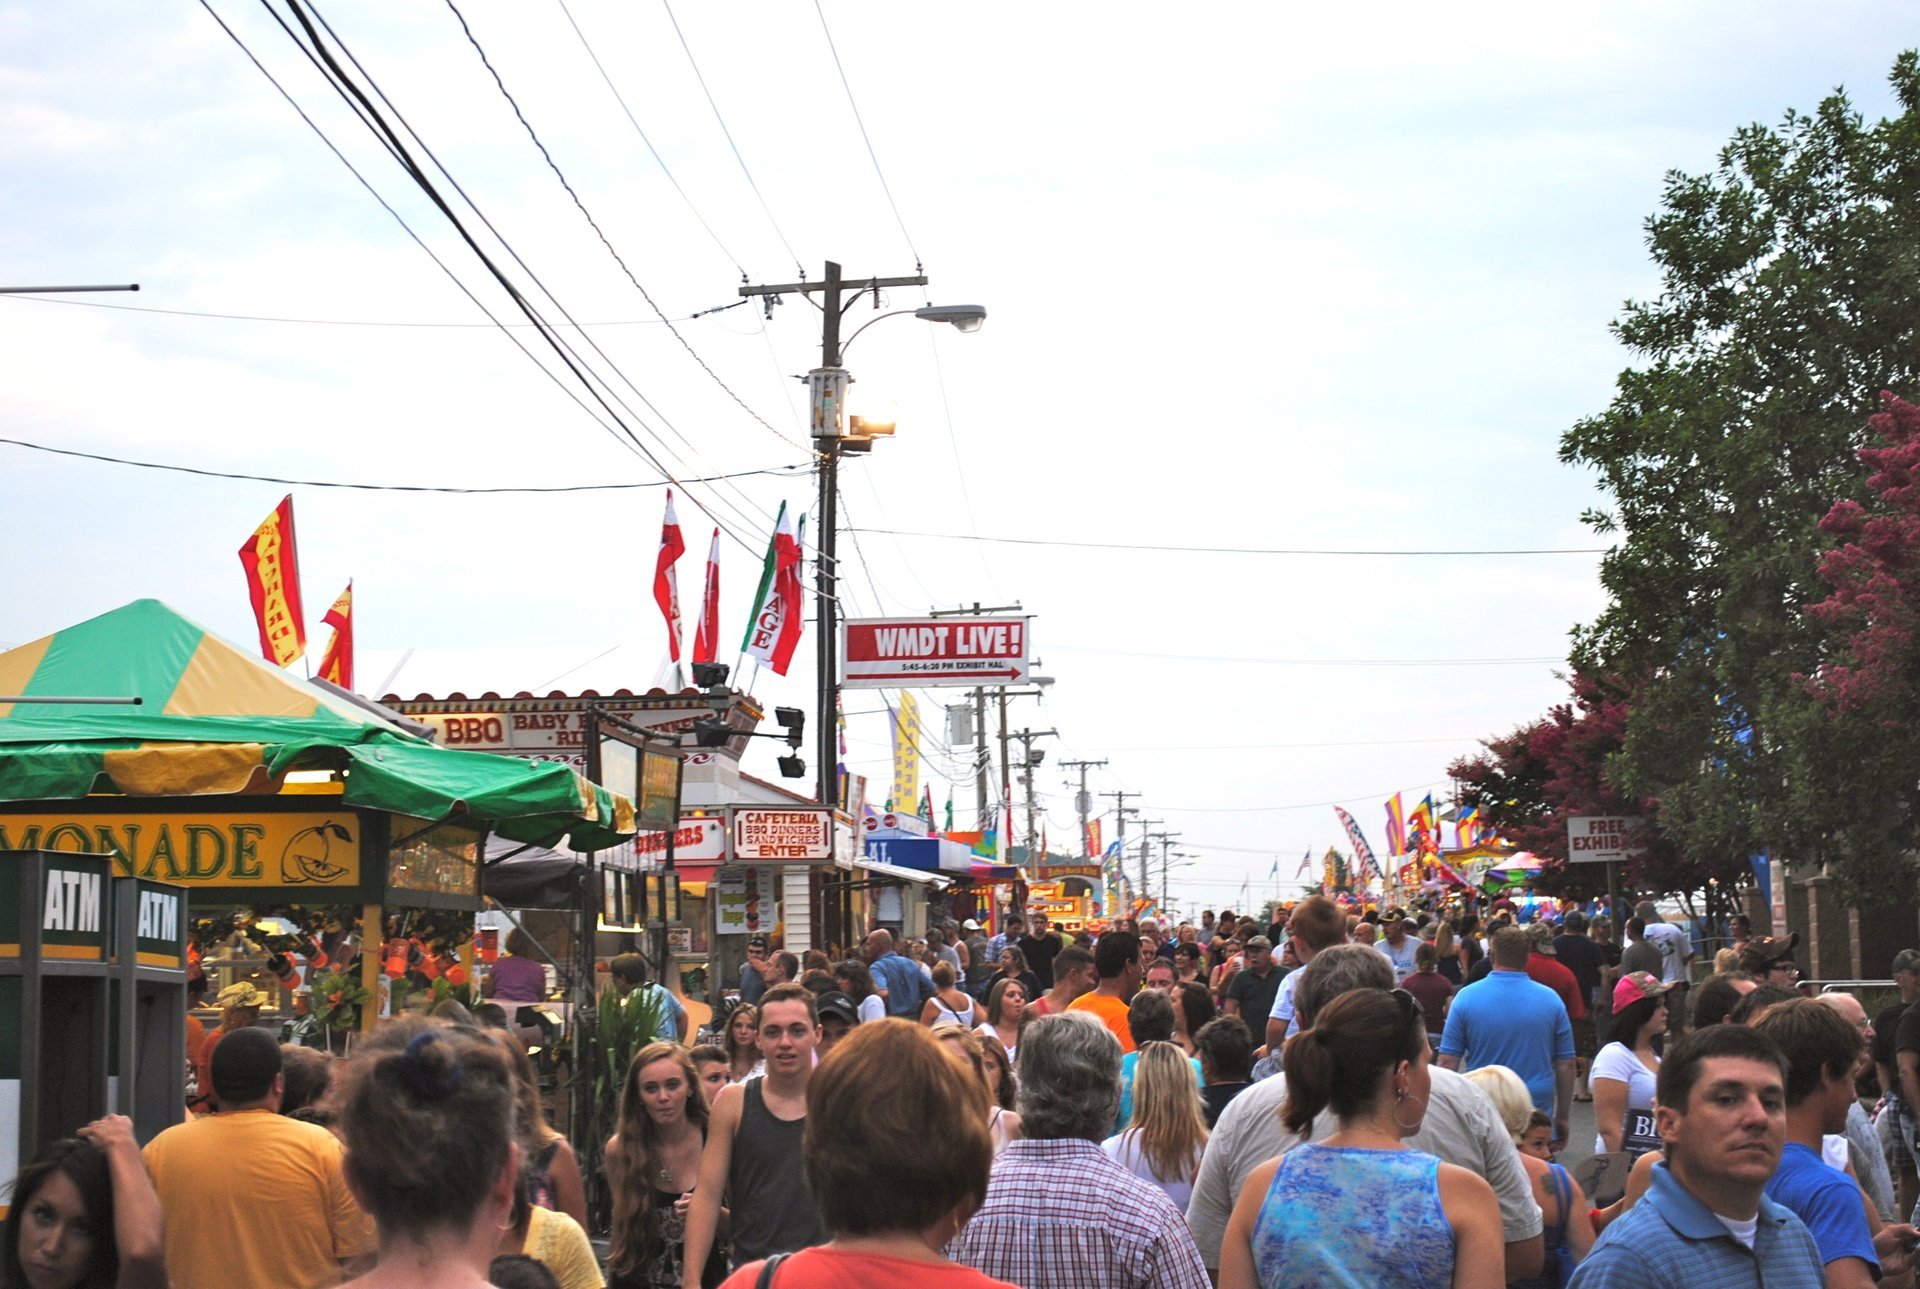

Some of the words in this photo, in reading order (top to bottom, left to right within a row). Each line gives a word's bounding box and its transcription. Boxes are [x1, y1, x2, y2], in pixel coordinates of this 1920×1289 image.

[752, 587, 780, 649] AGE
[875, 627, 949, 657] WMDT
[956, 625, 1021, 655] LIVE!
[942, 662, 954, 670] PM
[956, 661, 985, 669] EXHIBIT
[512, 714, 569, 730] BABY
[443, 717, 504, 744] BBQ
[746, 812, 819, 824] CAFETERIA
[746, 825, 768, 834] BBQ
[771, 825, 820, 835] DINNERS
[1588, 819, 1626, 834] FREE
[635, 825, 703, 855] DINERS
[746, 835, 820, 845] SANDWICHES
[1572, 835, 1624, 851] EXHIB
[759, 845, 808, 857] ENTER
[44, 869, 100, 932] ATM
[138, 890, 177, 941] ATM
